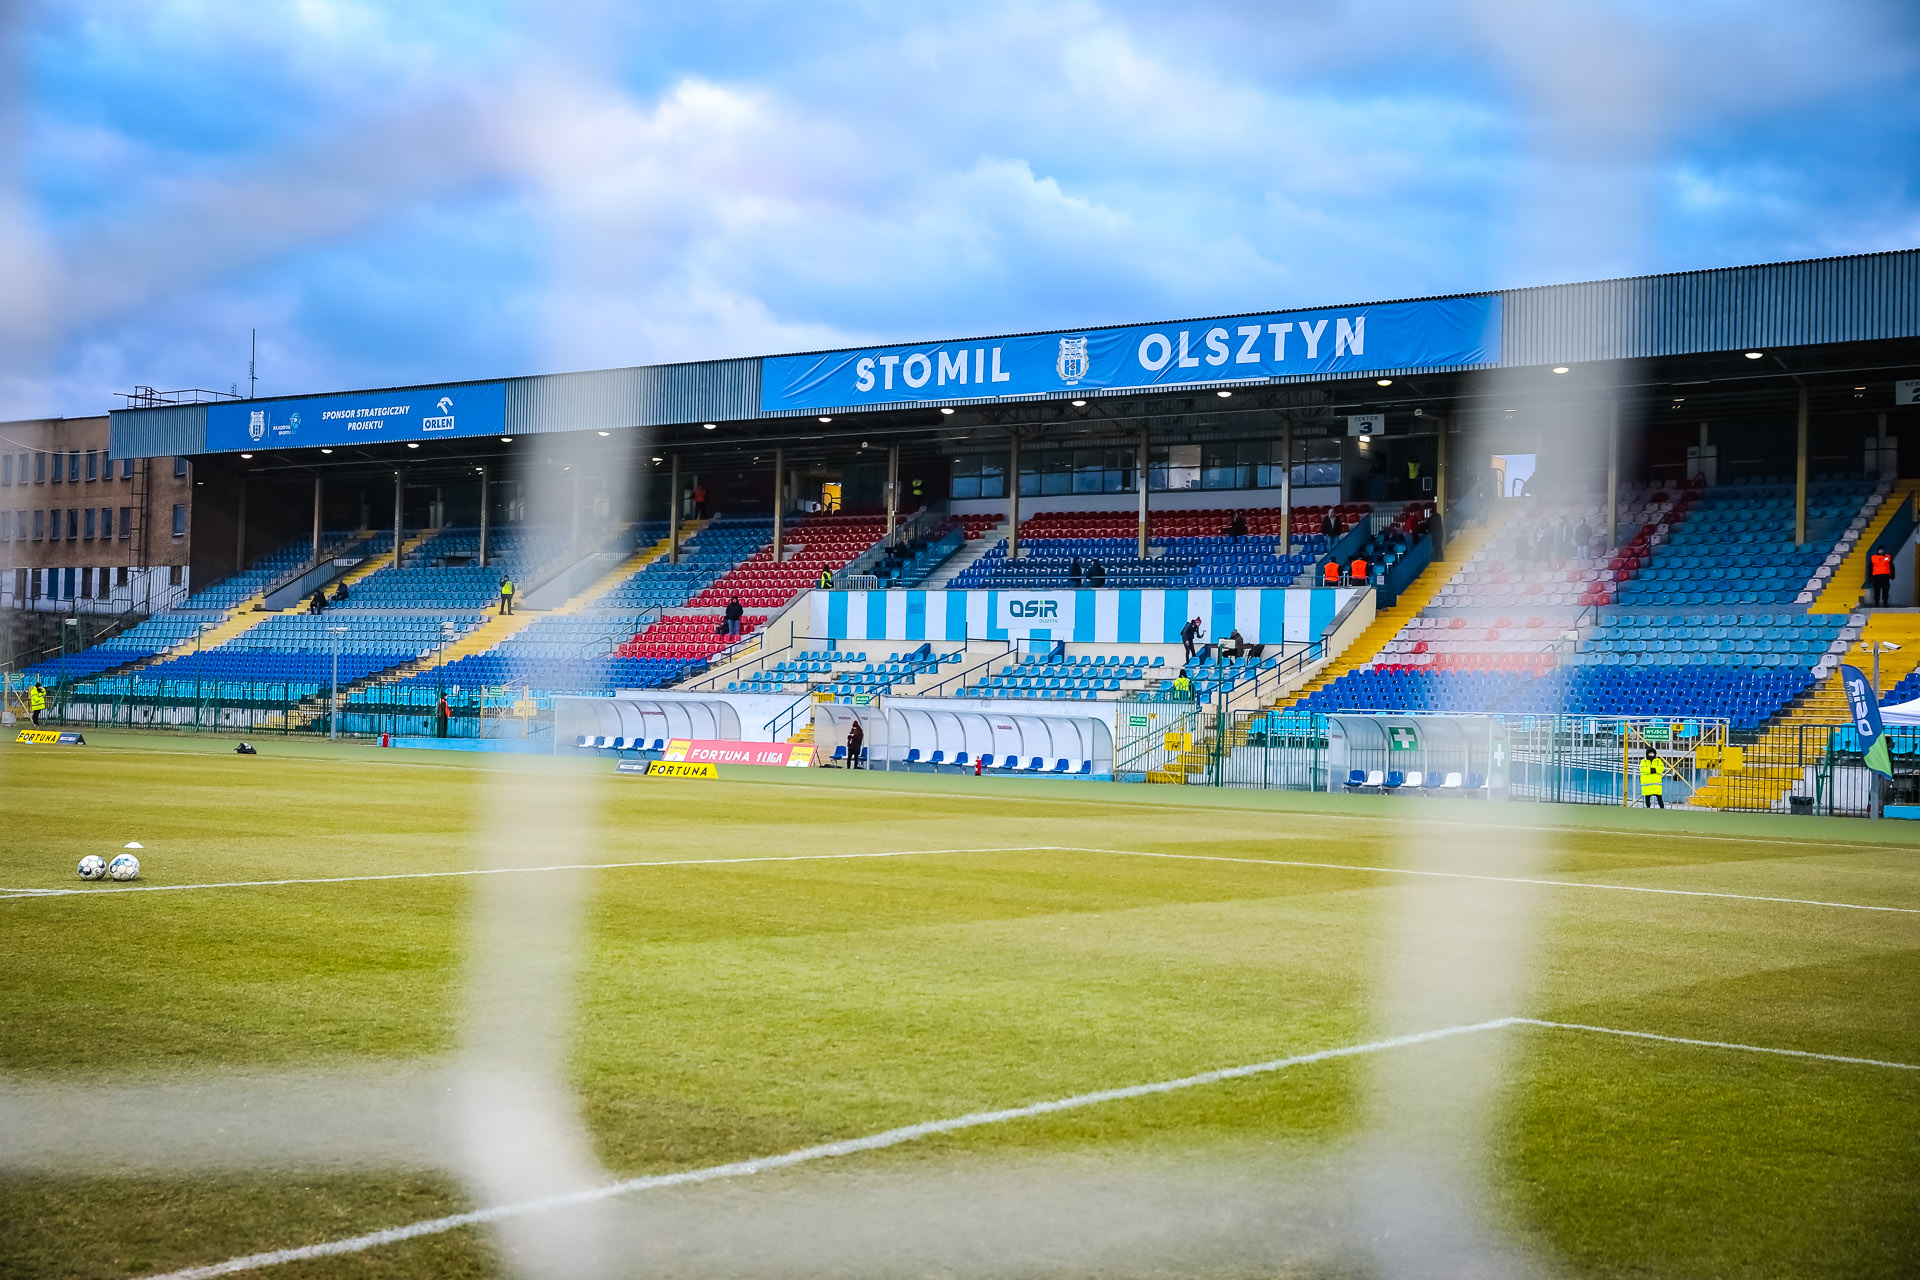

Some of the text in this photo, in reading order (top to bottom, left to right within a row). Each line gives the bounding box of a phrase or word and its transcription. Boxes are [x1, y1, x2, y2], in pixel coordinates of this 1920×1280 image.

[1138, 316, 1366, 372] OLSZTYN
[855, 347, 1010, 392] STOMIL
[322, 405, 410, 420] SPONSOR STRATEGICZNY
[347, 420, 383, 431] PROJEKTU
[424, 418, 453, 429] ORLEN
[1359, 421, 1373, 434] 3
[17, 733, 57, 742] FORTUNA
[691, 749, 783, 763] FORTUNA 1 LIGA
[650, 764, 708, 776] FORTUNA
